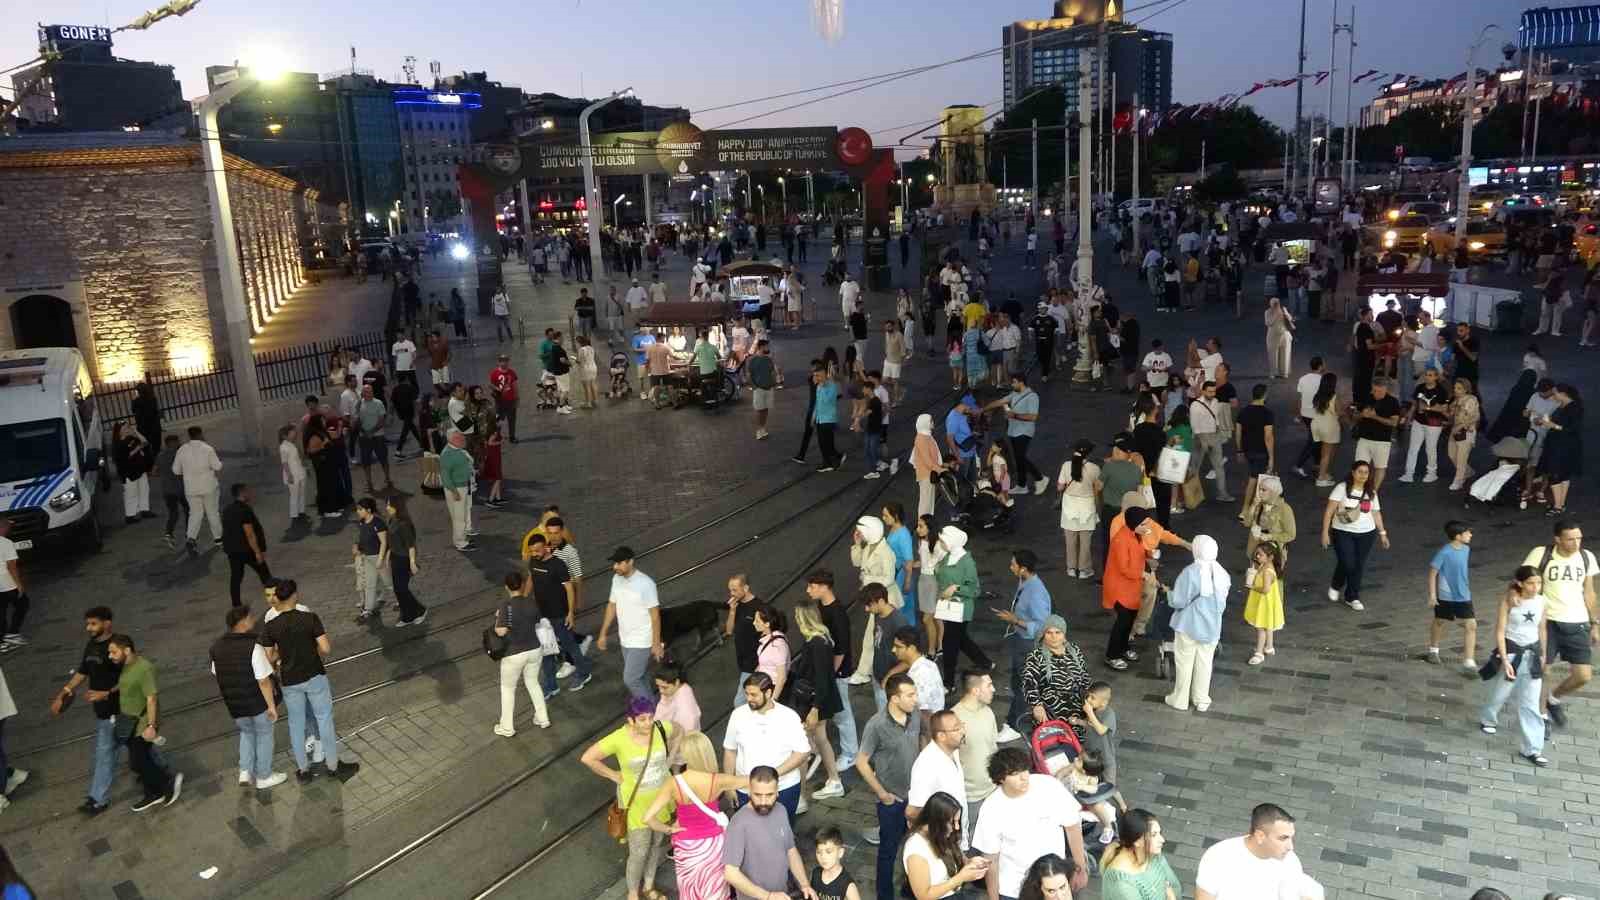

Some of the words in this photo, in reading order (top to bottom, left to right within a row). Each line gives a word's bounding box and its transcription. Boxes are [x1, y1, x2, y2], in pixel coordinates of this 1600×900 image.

[718, 138, 746, 150] HAPPY
[729, 151, 745, 161] THE
[745, 150, 783, 161] REPUBLIC
[1548, 565, 1585, 582] GAP
